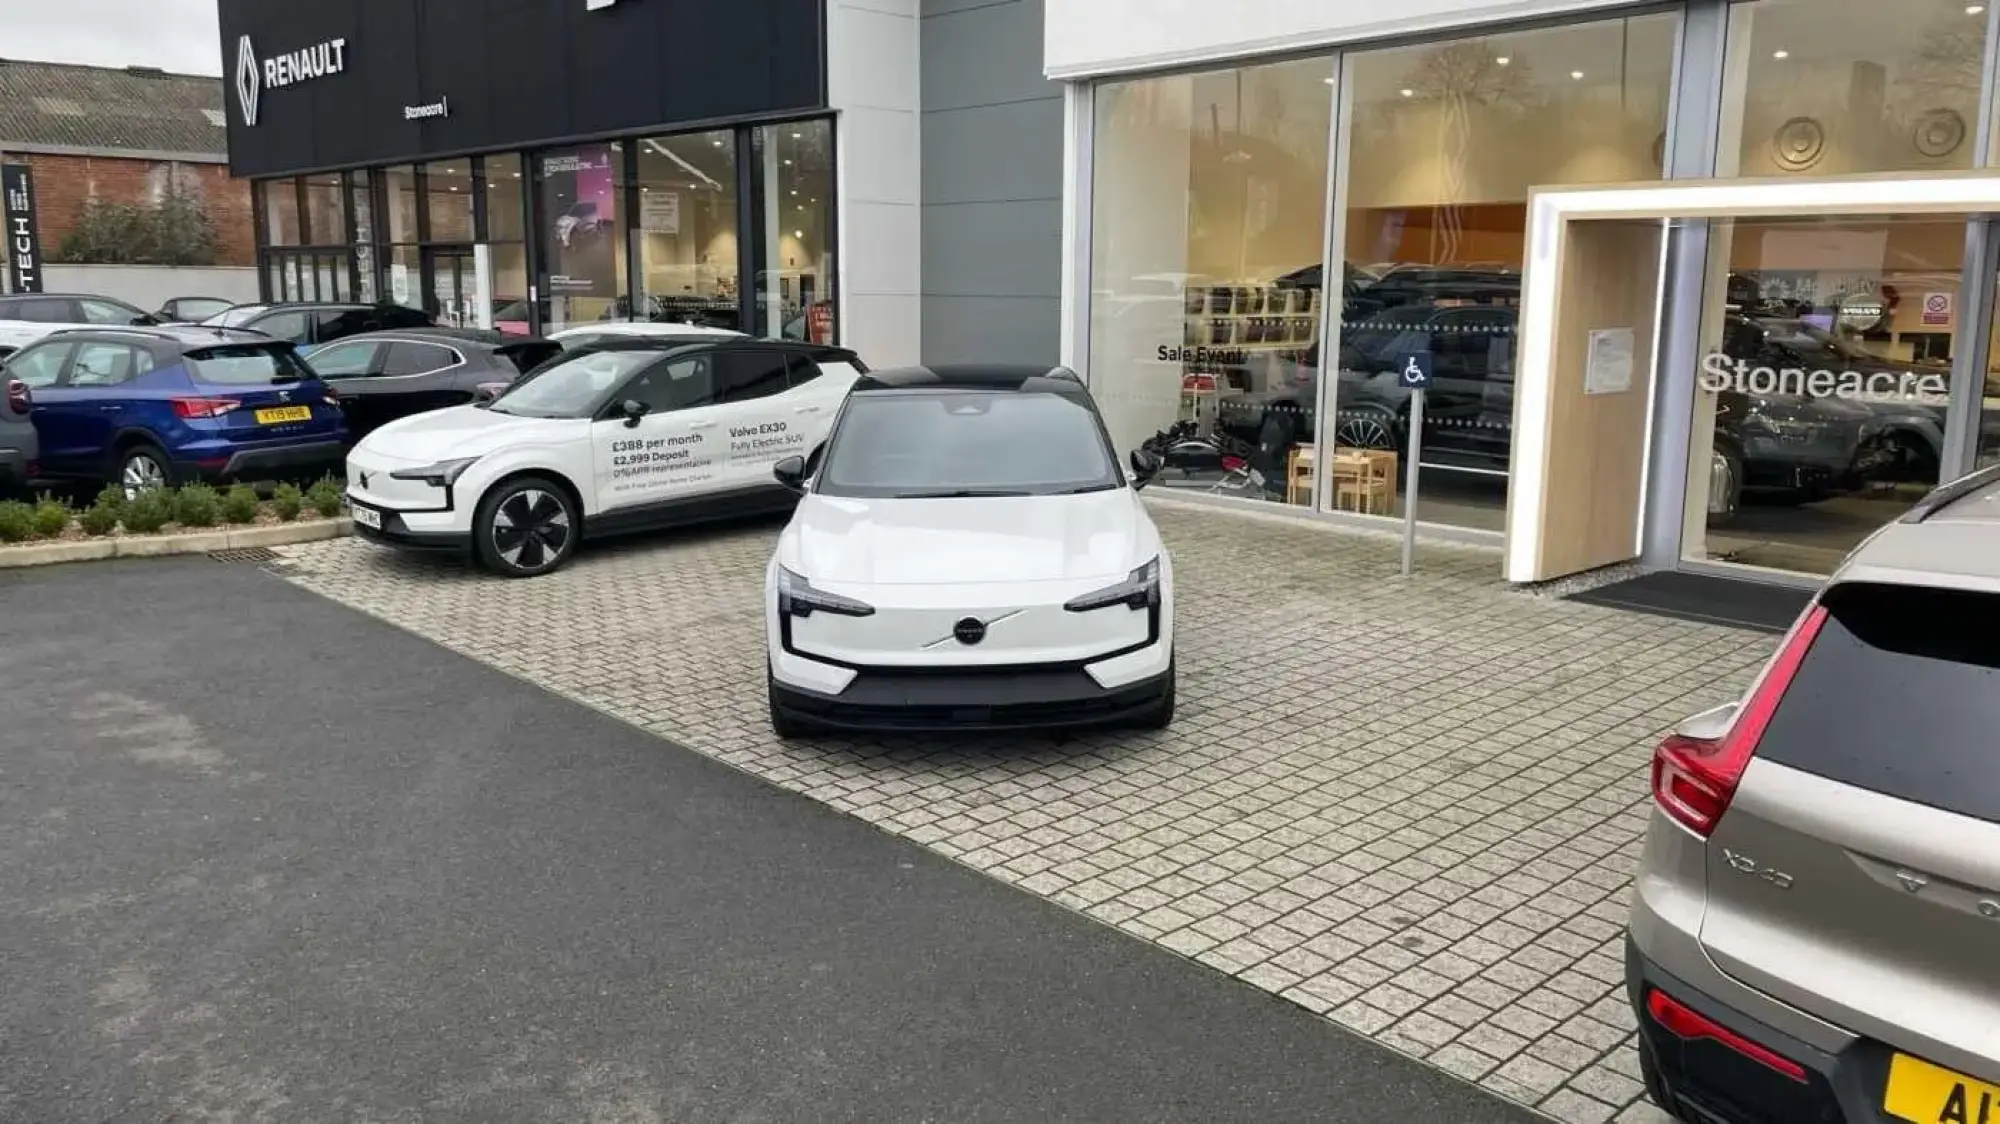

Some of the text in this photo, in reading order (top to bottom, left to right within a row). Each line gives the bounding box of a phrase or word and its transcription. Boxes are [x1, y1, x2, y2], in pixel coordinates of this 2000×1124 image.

[264, 38, 345, 89] RENAULT
[1157, 345, 1243, 363] Sale Event
[1699, 352, 1946, 401] Stoneacre
[729, 422, 787, 438] Volvo EX30
[612, 432, 703, 452] £388 per month
[752, 437, 783, 448] Electric
[652, 449, 689, 461] Deposit
